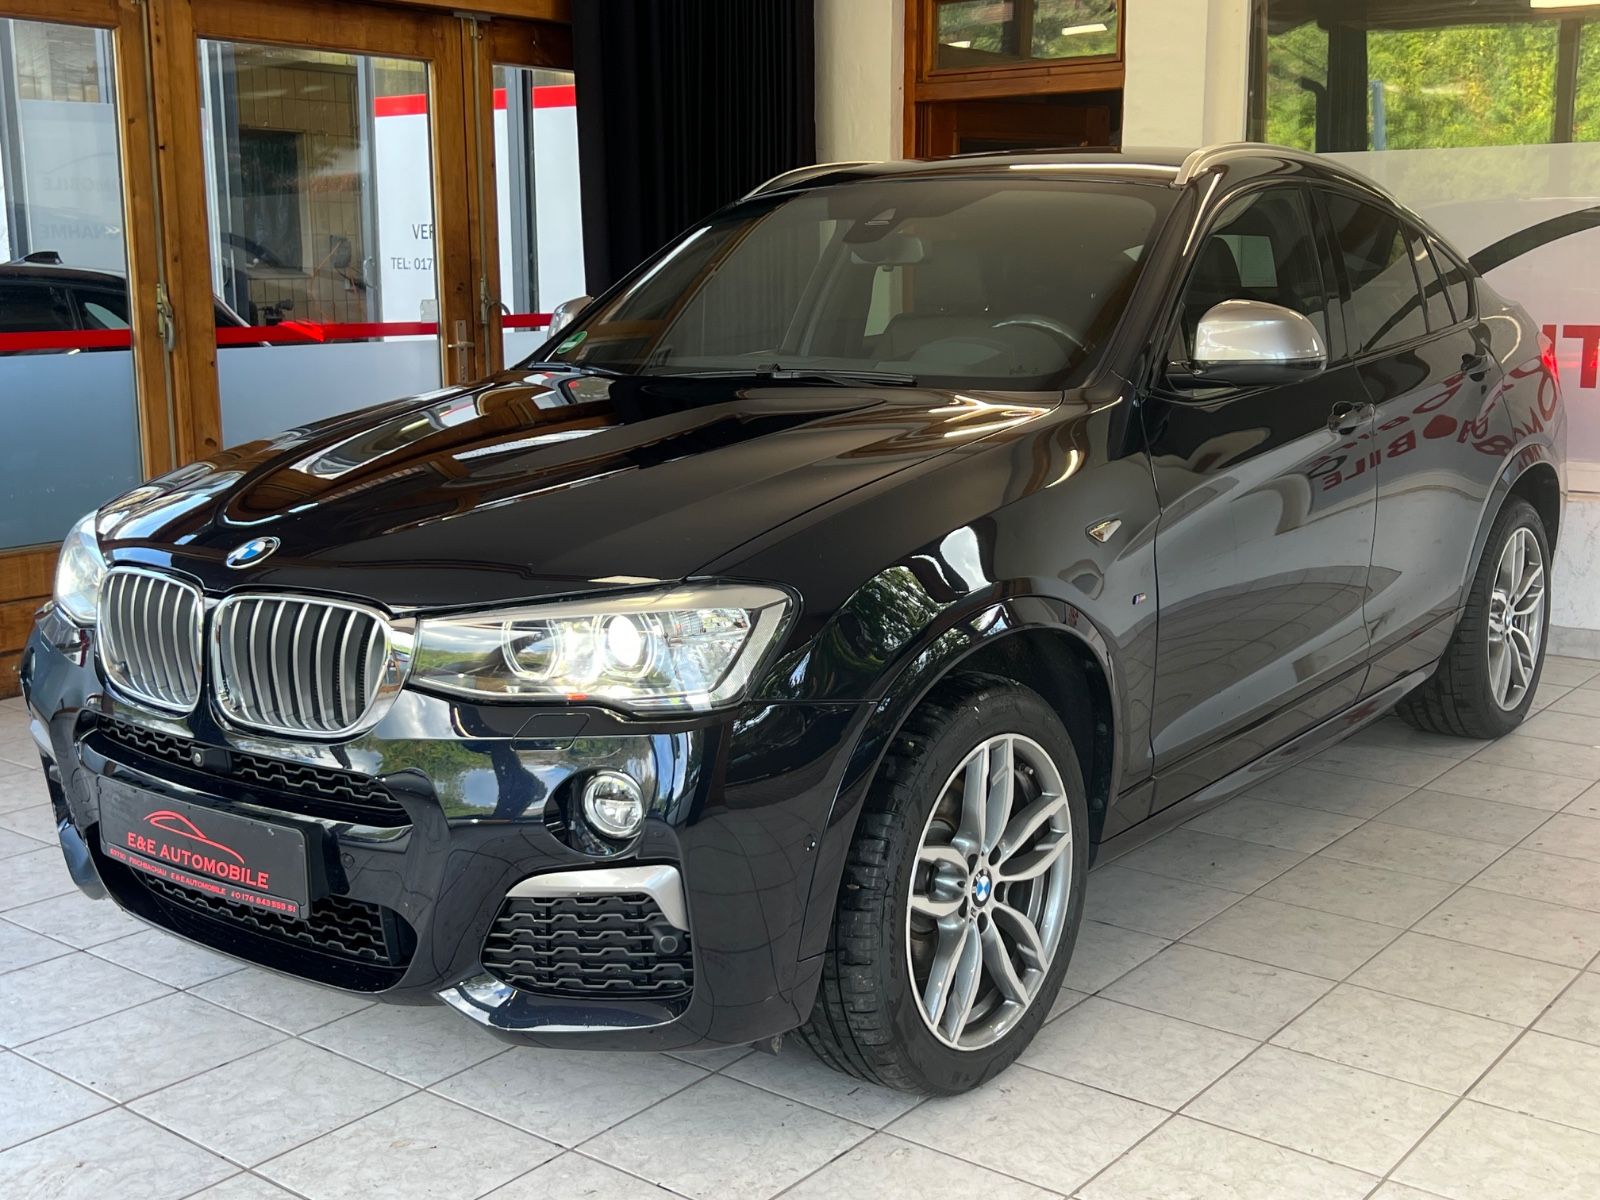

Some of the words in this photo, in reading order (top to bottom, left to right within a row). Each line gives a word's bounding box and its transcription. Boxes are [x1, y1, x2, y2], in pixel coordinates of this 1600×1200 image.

[391, 256, 411, 270] TEL:
[127, 832, 156, 855] E&E
[160, 844, 269, 889] AUTOMOBILE
